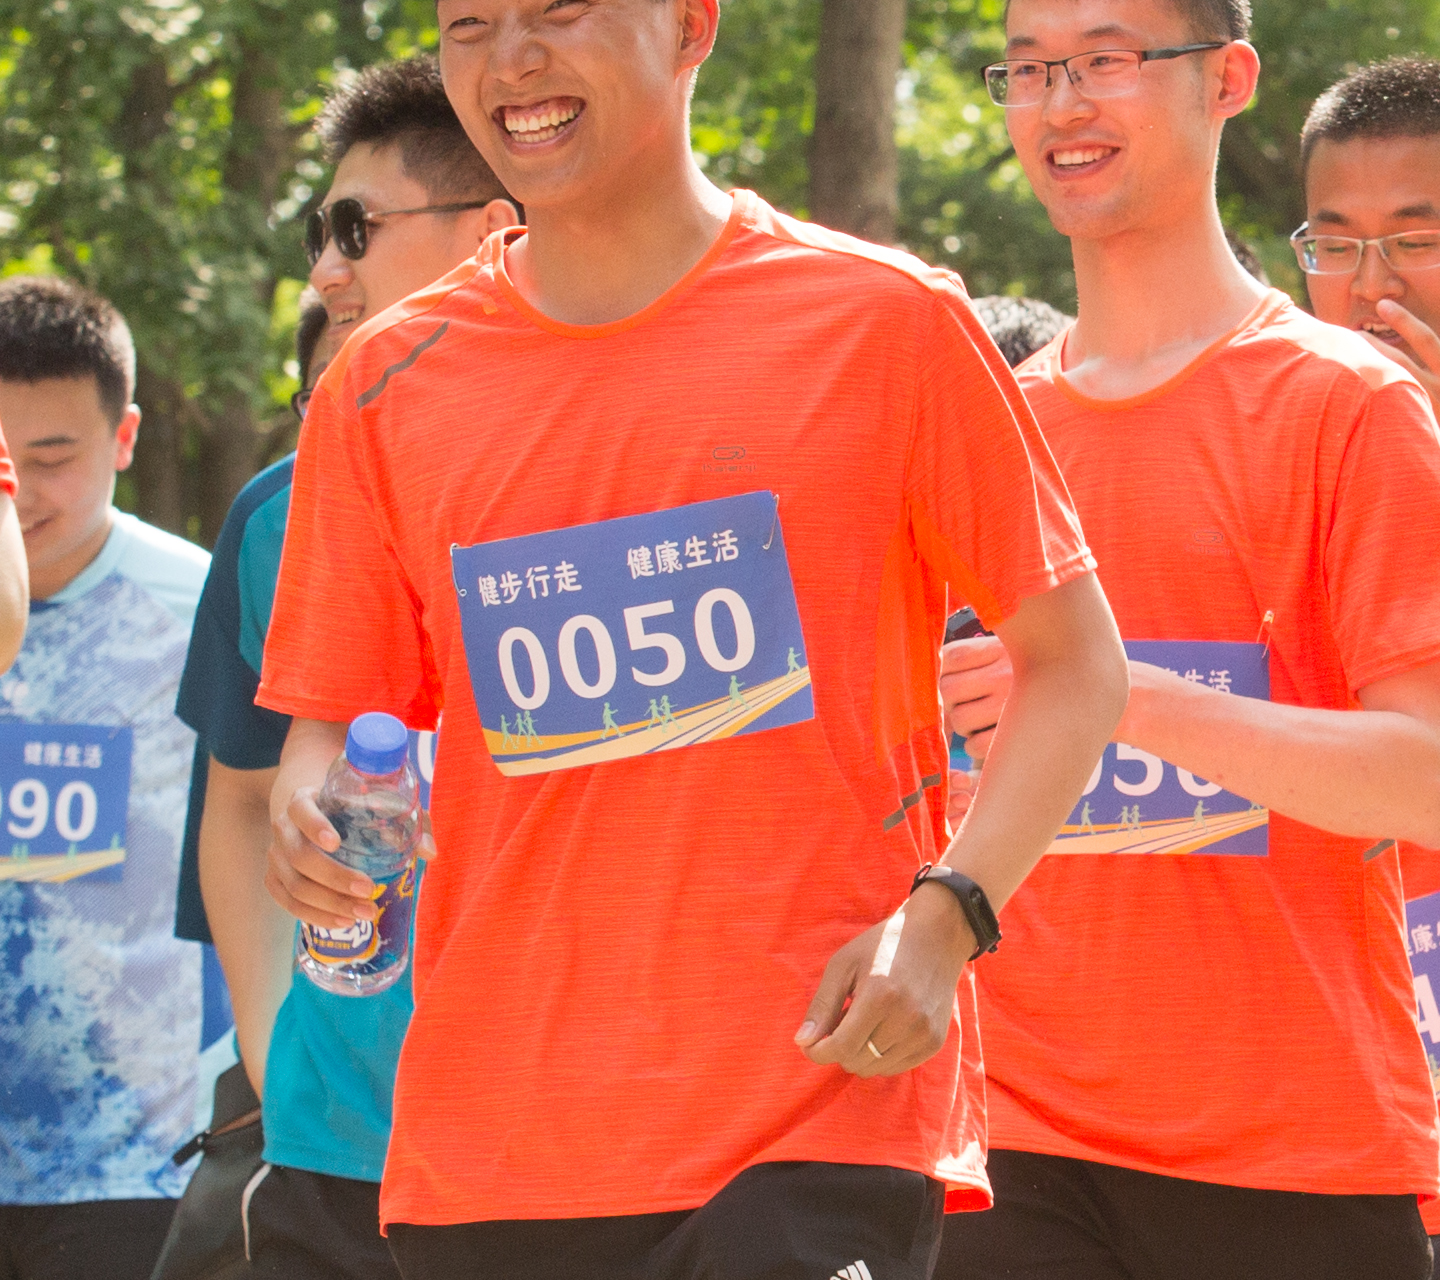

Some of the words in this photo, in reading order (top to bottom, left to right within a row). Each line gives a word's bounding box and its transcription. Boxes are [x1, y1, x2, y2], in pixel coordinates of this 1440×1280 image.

[478, 560, 582, 607] 健步行走
[626, 529, 740, 580] 健康生活
[497, 587, 756, 711] 0050
